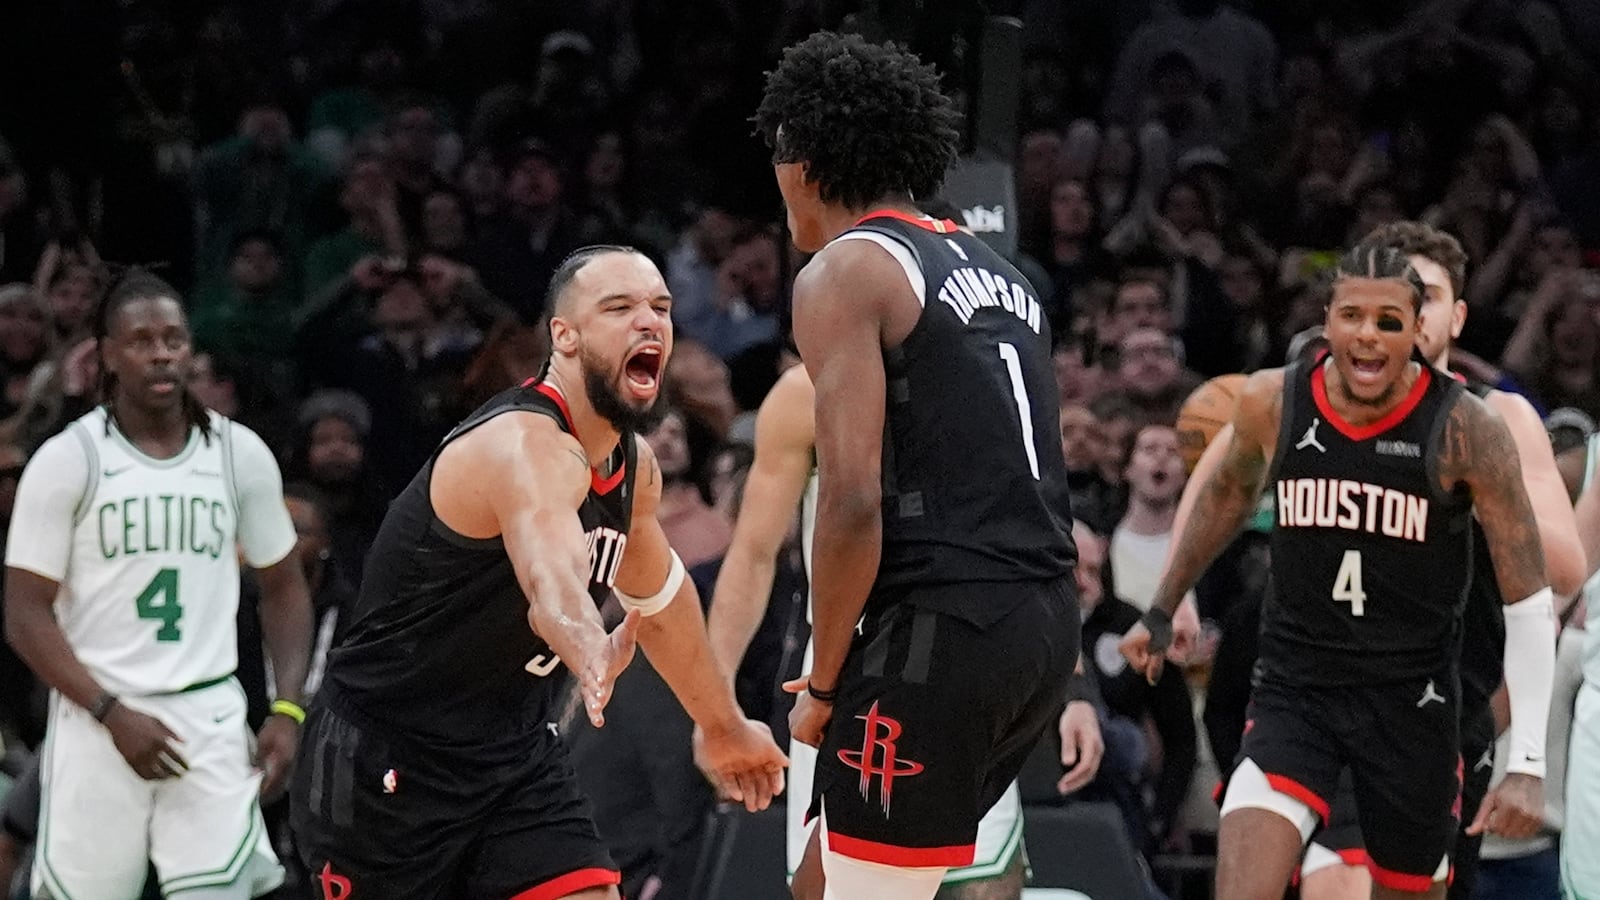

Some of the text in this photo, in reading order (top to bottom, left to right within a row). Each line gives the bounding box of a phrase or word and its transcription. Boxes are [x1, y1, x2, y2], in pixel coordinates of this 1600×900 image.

[938, 267, 1041, 334] THOMPSON
[998, 342, 1040, 480] 1
[99, 496, 226, 559] CELTICS
[1277, 478, 1428, 542] HOUSTON
[136, 568, 183, 641] 4
[1332, 549, 1367, 617] 4
